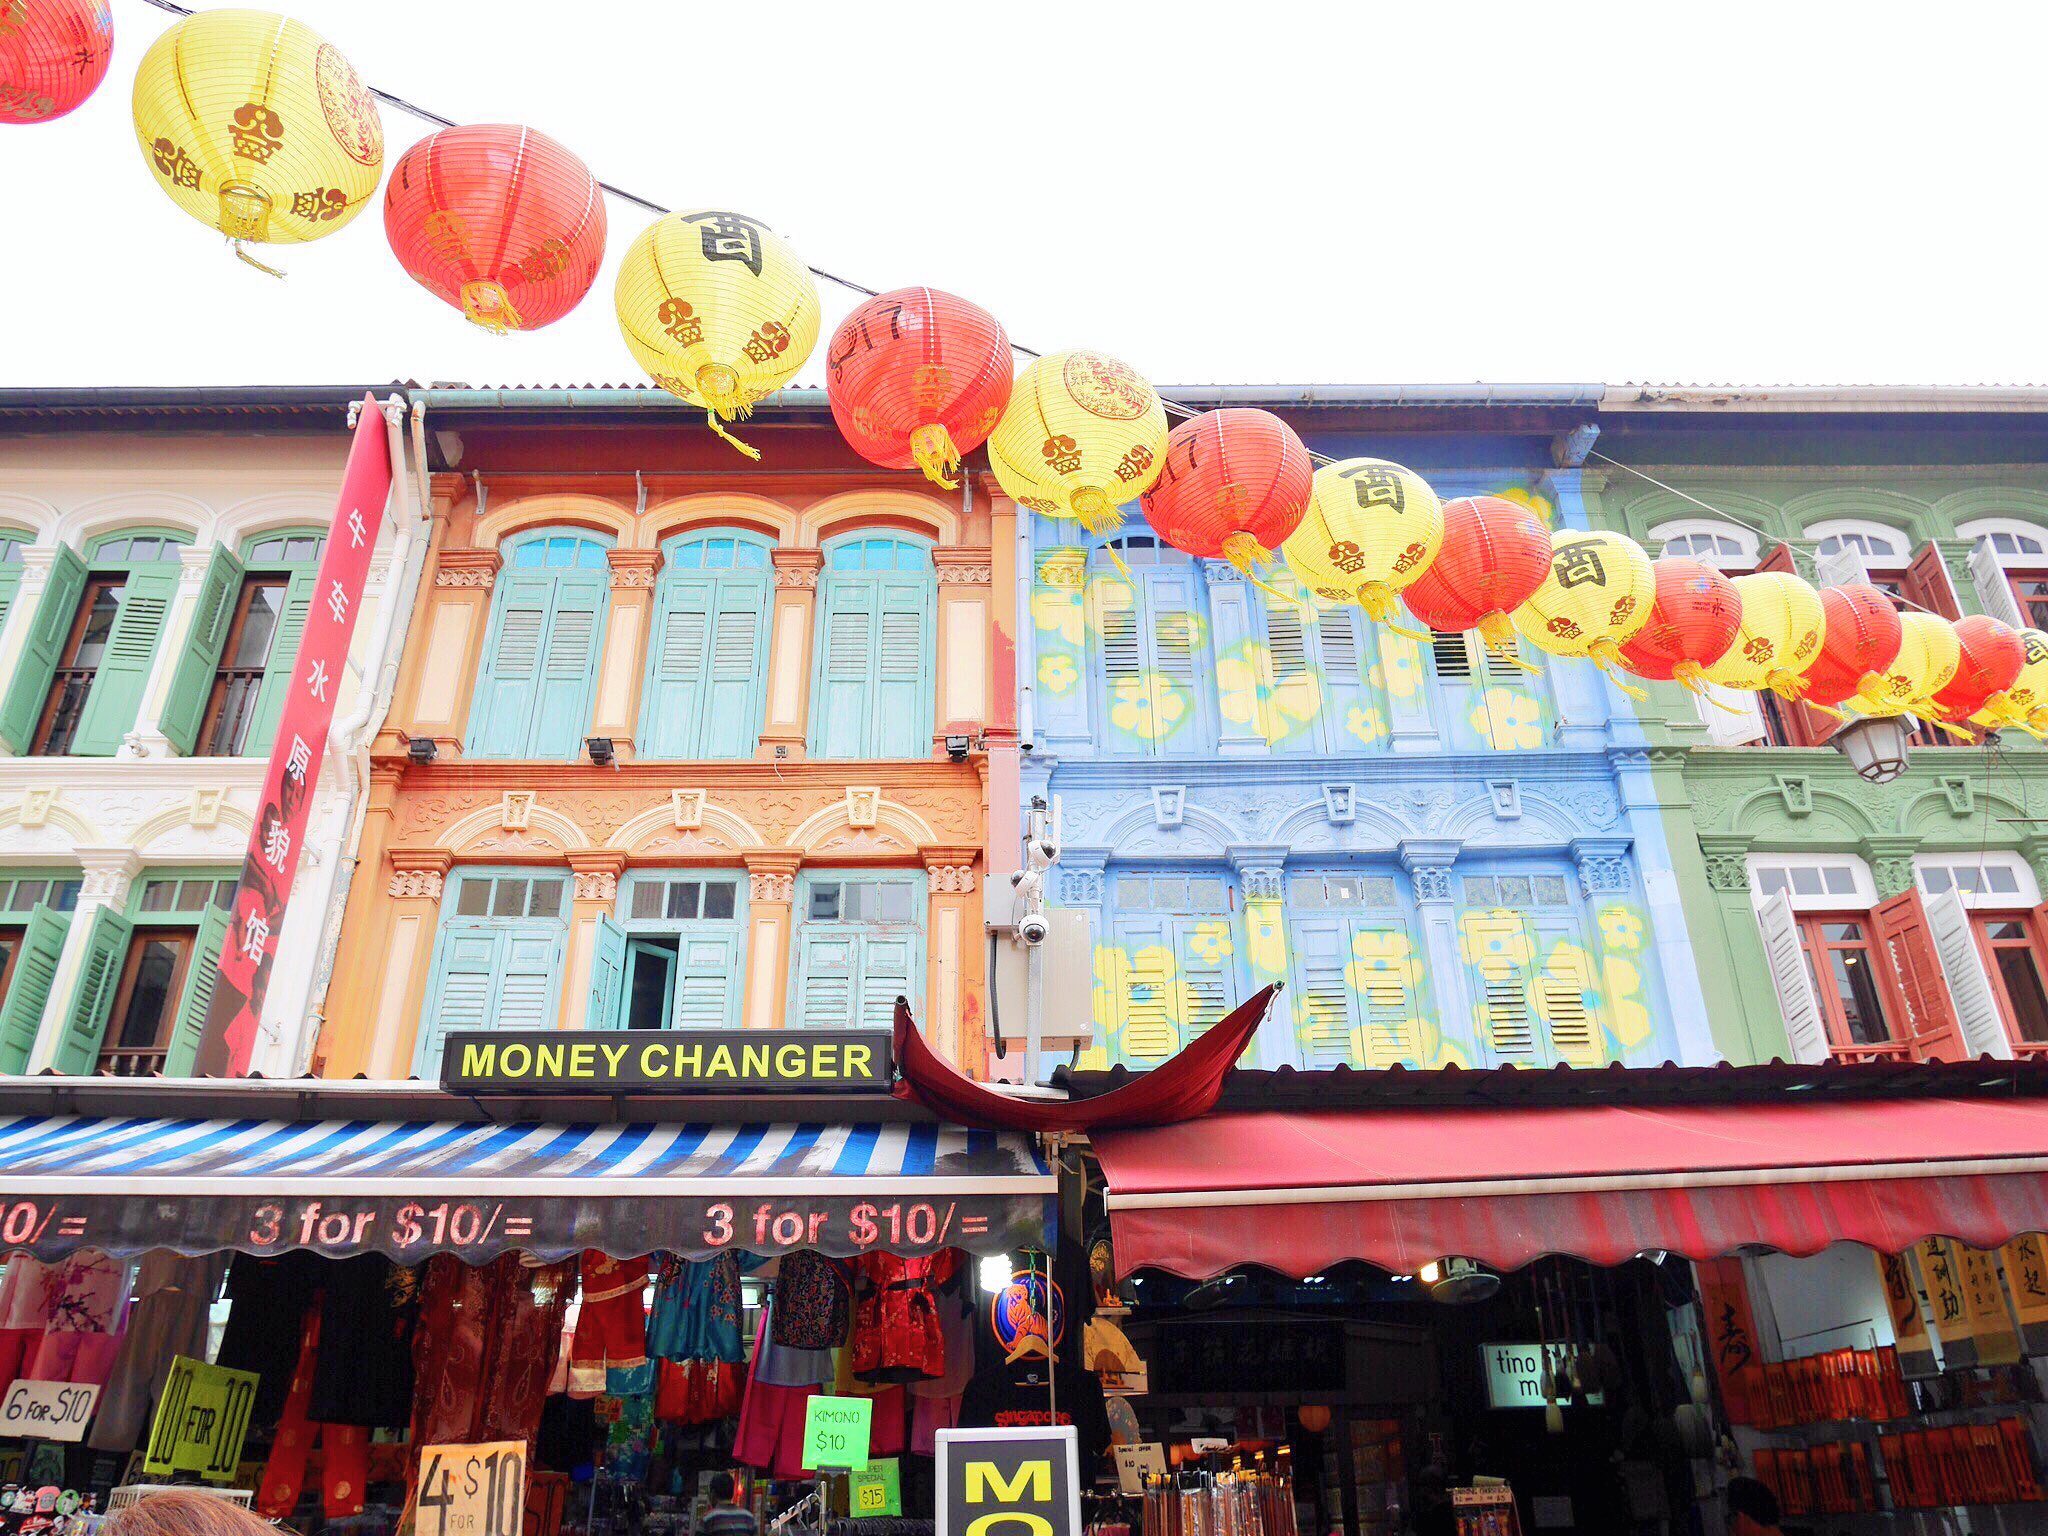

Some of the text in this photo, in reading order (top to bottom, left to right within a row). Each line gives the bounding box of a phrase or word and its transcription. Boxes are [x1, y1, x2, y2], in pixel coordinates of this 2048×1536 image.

[681, 211, 771, 278] 酉
[1338, 464, 1410, 514] 酉
[1552, 539, 1608, 589] 酉
[242, 507, 367, 966] 牛车水原貌馆
[461, 1043, 874, 1079] MONEY CHANGER
[250, 1203, 284, 1245] 3
[300, 1202, 376, 1244] for
[703, 1203, 735, 1246] 3
[752, 1204, 828, 1245] for
[1497, 1350, 1536, 1374] tino
[6, 1387, 91, 1424] 6 FOR $10
[149, 1368, 193, 1465] 10
[183, 1405, 216, 1445] FOR
[207, 1378, 254, 1472] 10
[814, 1410, 860, 1424] KIMONO
[816, 1430, 846, 1452] $10
[419, 1450, 522, 1536] 4 FOR $10
[857, 1473, 886, 1482] SPECIAL
[861, 1488, 883, 1505] $15
